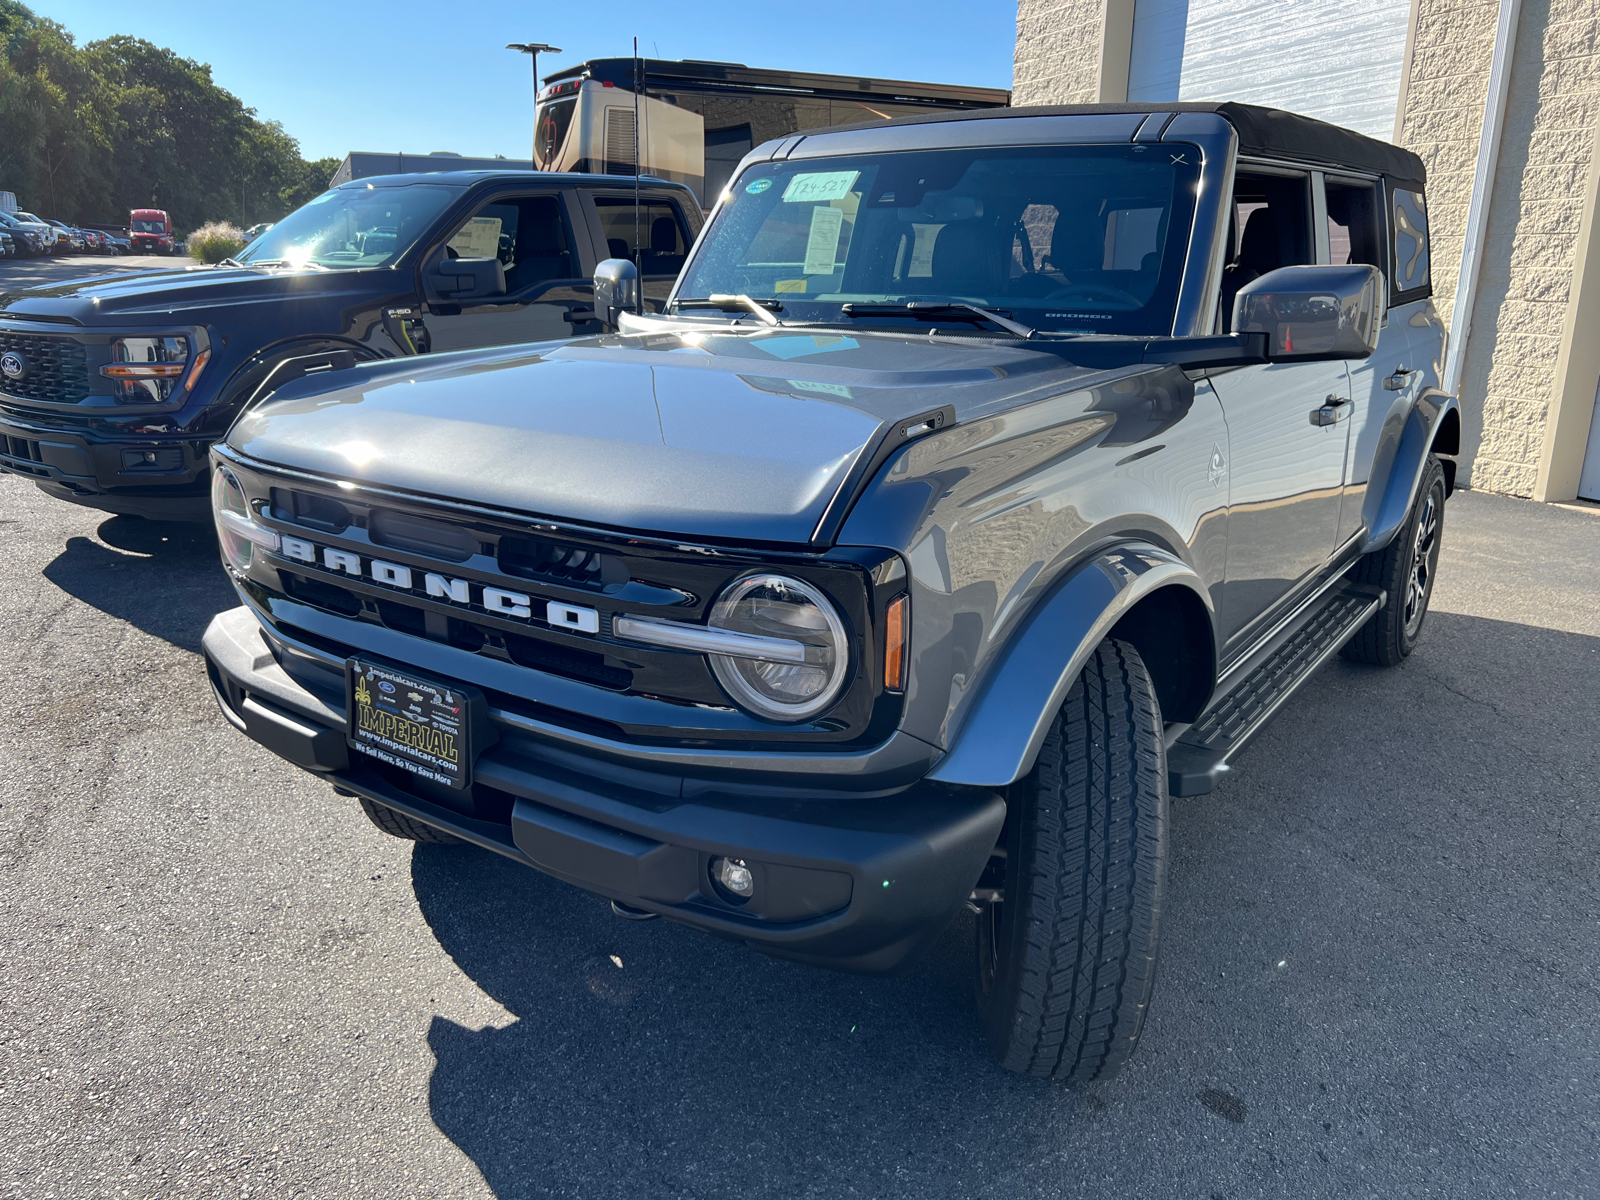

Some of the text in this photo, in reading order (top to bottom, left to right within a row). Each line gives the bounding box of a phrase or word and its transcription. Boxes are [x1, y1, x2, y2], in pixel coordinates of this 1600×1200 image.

[3, 356, 20, 373] Ford
[281, 534, 599, 634] BRONCO
[358, 728, 458, 772] www.imperialcars.com
[359, 703, 458, 763] IMPERIAL
[439, 723, 459, 735] TOYOTA
[355, 742, 452, 786] We Sell More, So You Save More
